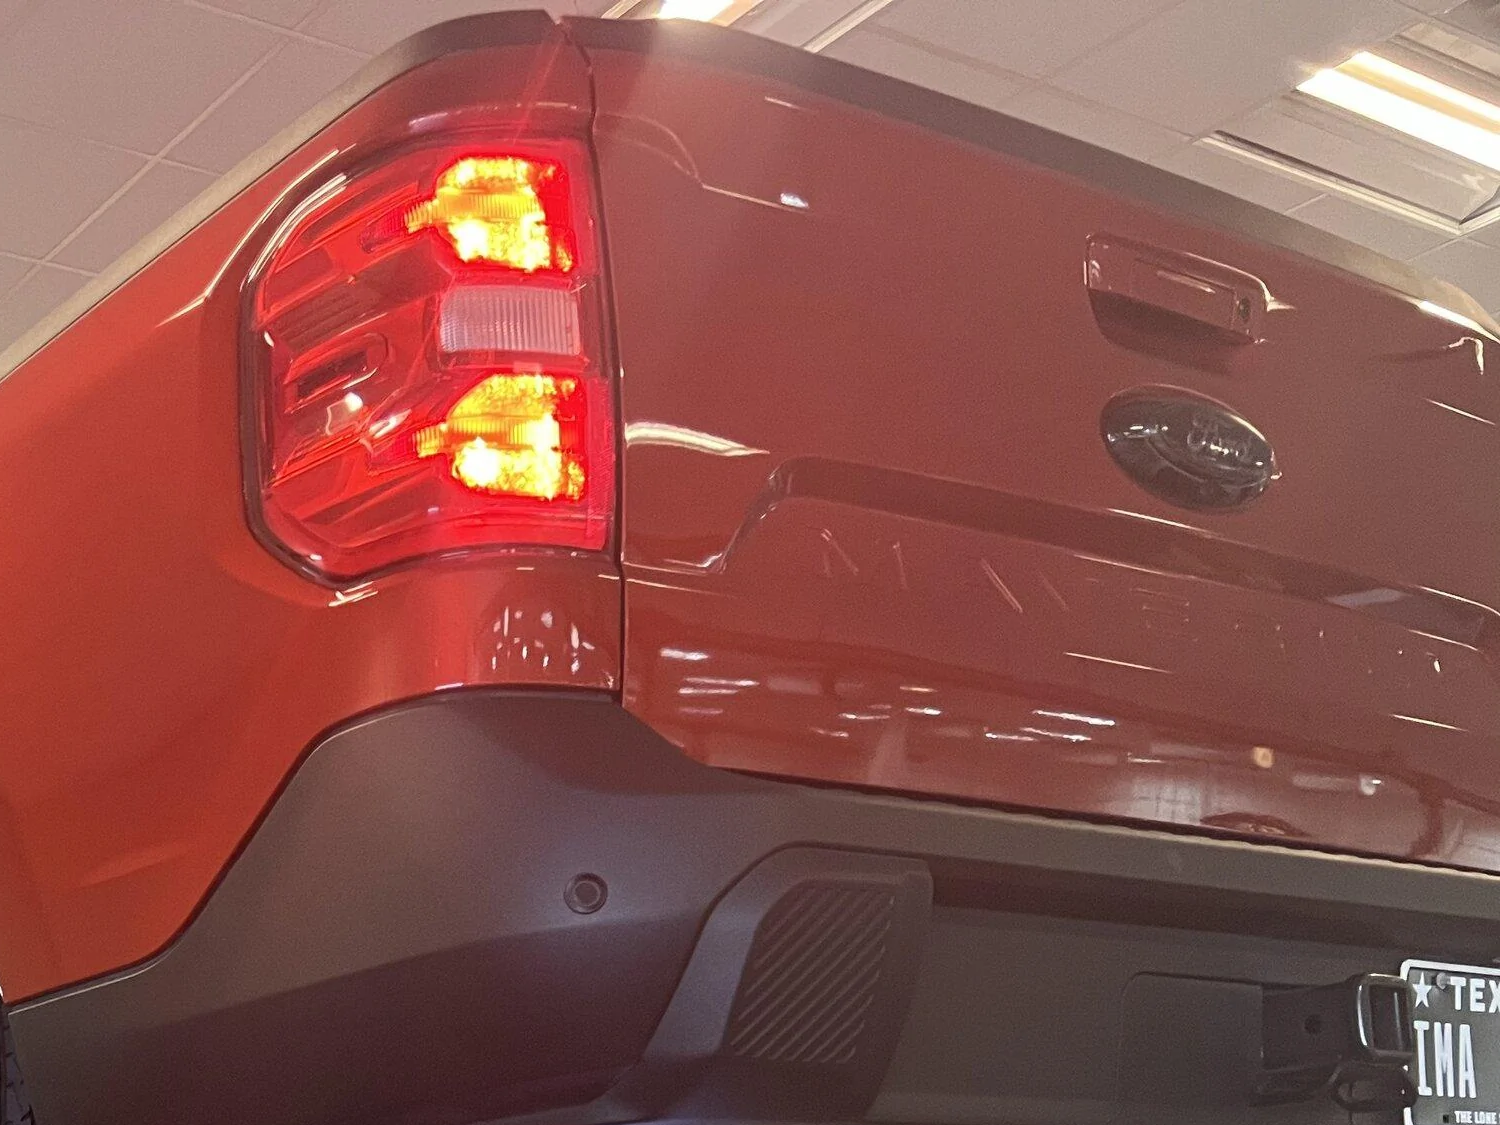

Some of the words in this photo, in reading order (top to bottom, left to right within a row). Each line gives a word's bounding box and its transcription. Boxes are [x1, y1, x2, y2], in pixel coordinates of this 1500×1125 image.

[1450, 976, 1500, 1013] TEX
[1413, 1020, 1477, 1098] IMA
[1454, 1110, 1473, 1124] THE
[1474, 1111, 1497, 1125] LONE
